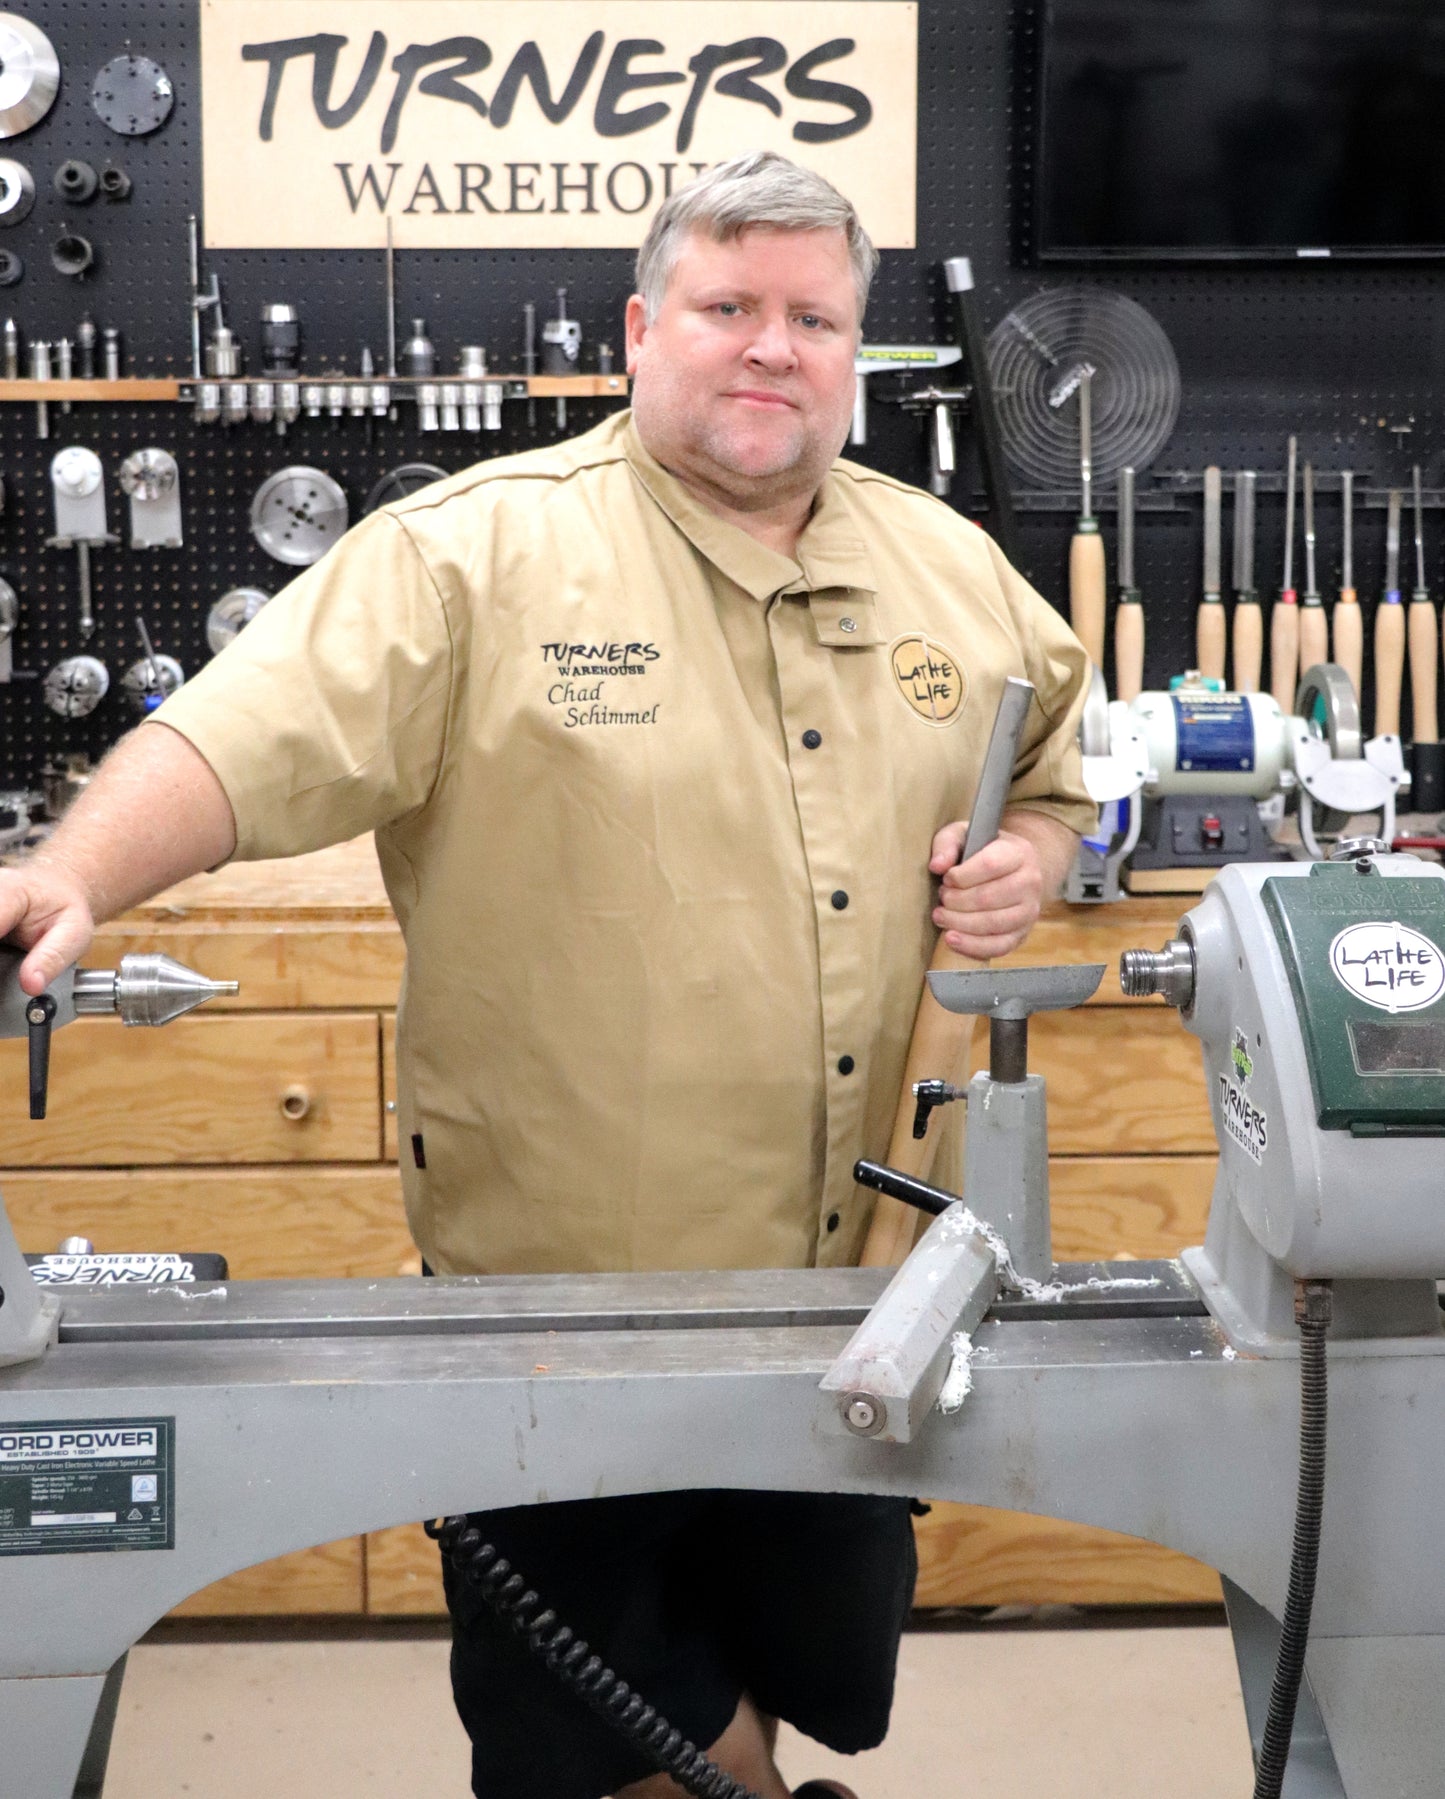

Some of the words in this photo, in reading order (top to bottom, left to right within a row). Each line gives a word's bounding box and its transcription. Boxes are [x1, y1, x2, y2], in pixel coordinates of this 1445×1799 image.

[242, 30, 873, 153] TURNERS
[334, 162, 712, 213] WAREHOU
[541, 642, 660, 665] TURNERS
[558, 665, 645, 677] WAREHOUSE
[896, 655, 953, 680] LATHE
[548, 681, 605, 704] Chad
[913, 683, 953, 703] LIFE
[564, 704, 660, 728] Schimmel
[1342, 942, 1433, 965] LATHE
[1365, 968, 1426, 989] LIFE
[1220, 1077, 1267, 1146] TURNERS
[53, 1255, 177, 1265] WAREHOUSE
[31, 1265, 190, 1283] TURNERS
[0, 1435, 53, 1451] ORD
[59, 1432, 153, 1449] POWER
[21, 1463, 35, 1471] Duty
[65, 1461, 93, 1469] Electronic
[95, 1460, 120, 1468] Variable
[120, 1459, 138, 1468] Speed
